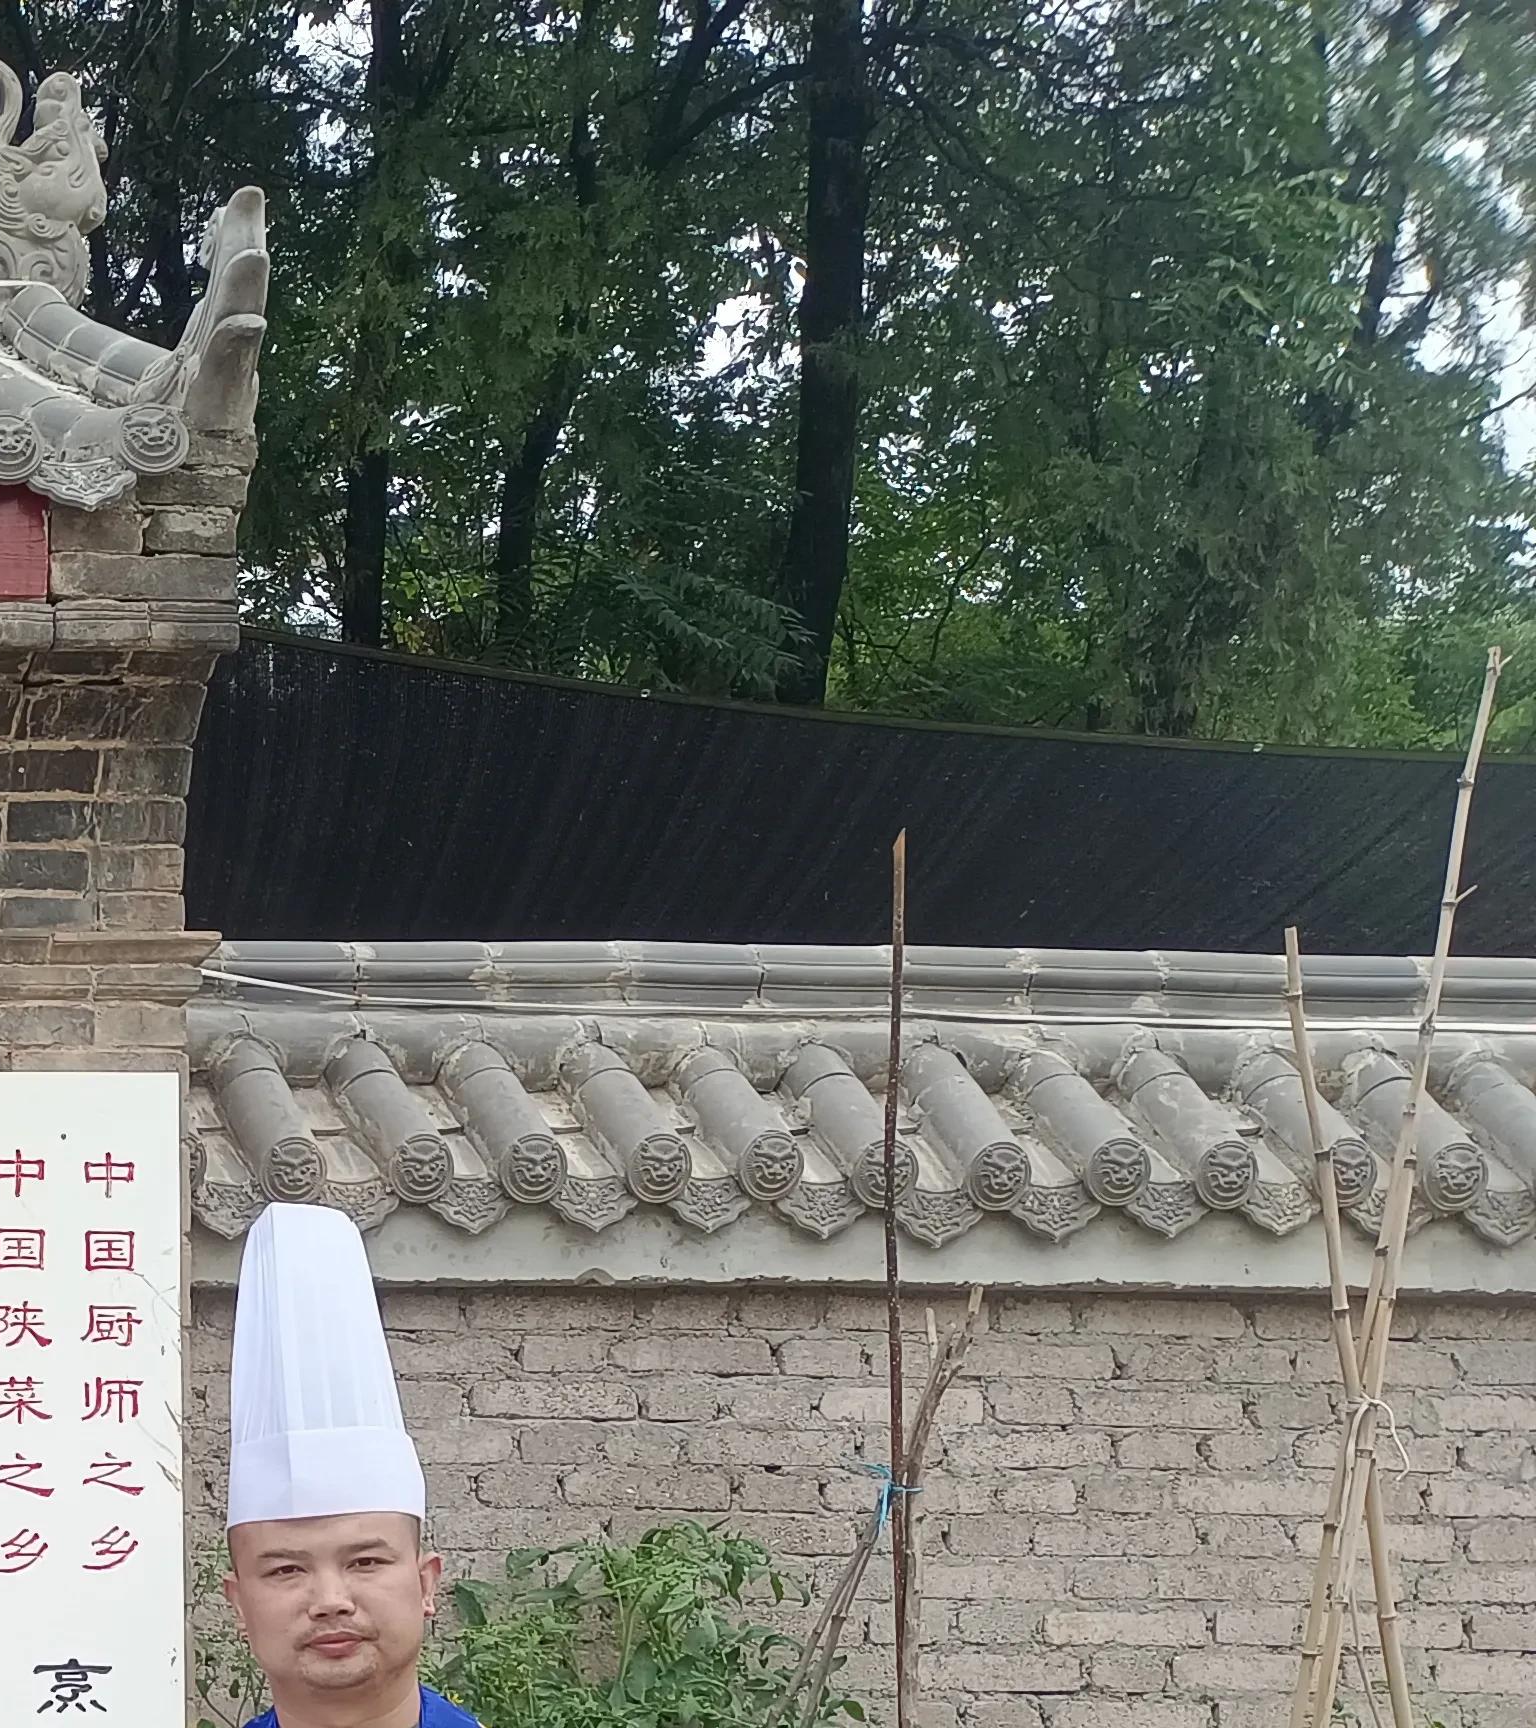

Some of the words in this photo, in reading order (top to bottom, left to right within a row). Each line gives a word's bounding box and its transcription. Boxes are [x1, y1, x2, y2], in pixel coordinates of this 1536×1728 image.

[81, 1150, 145, 1571] 中国厨师之乡
